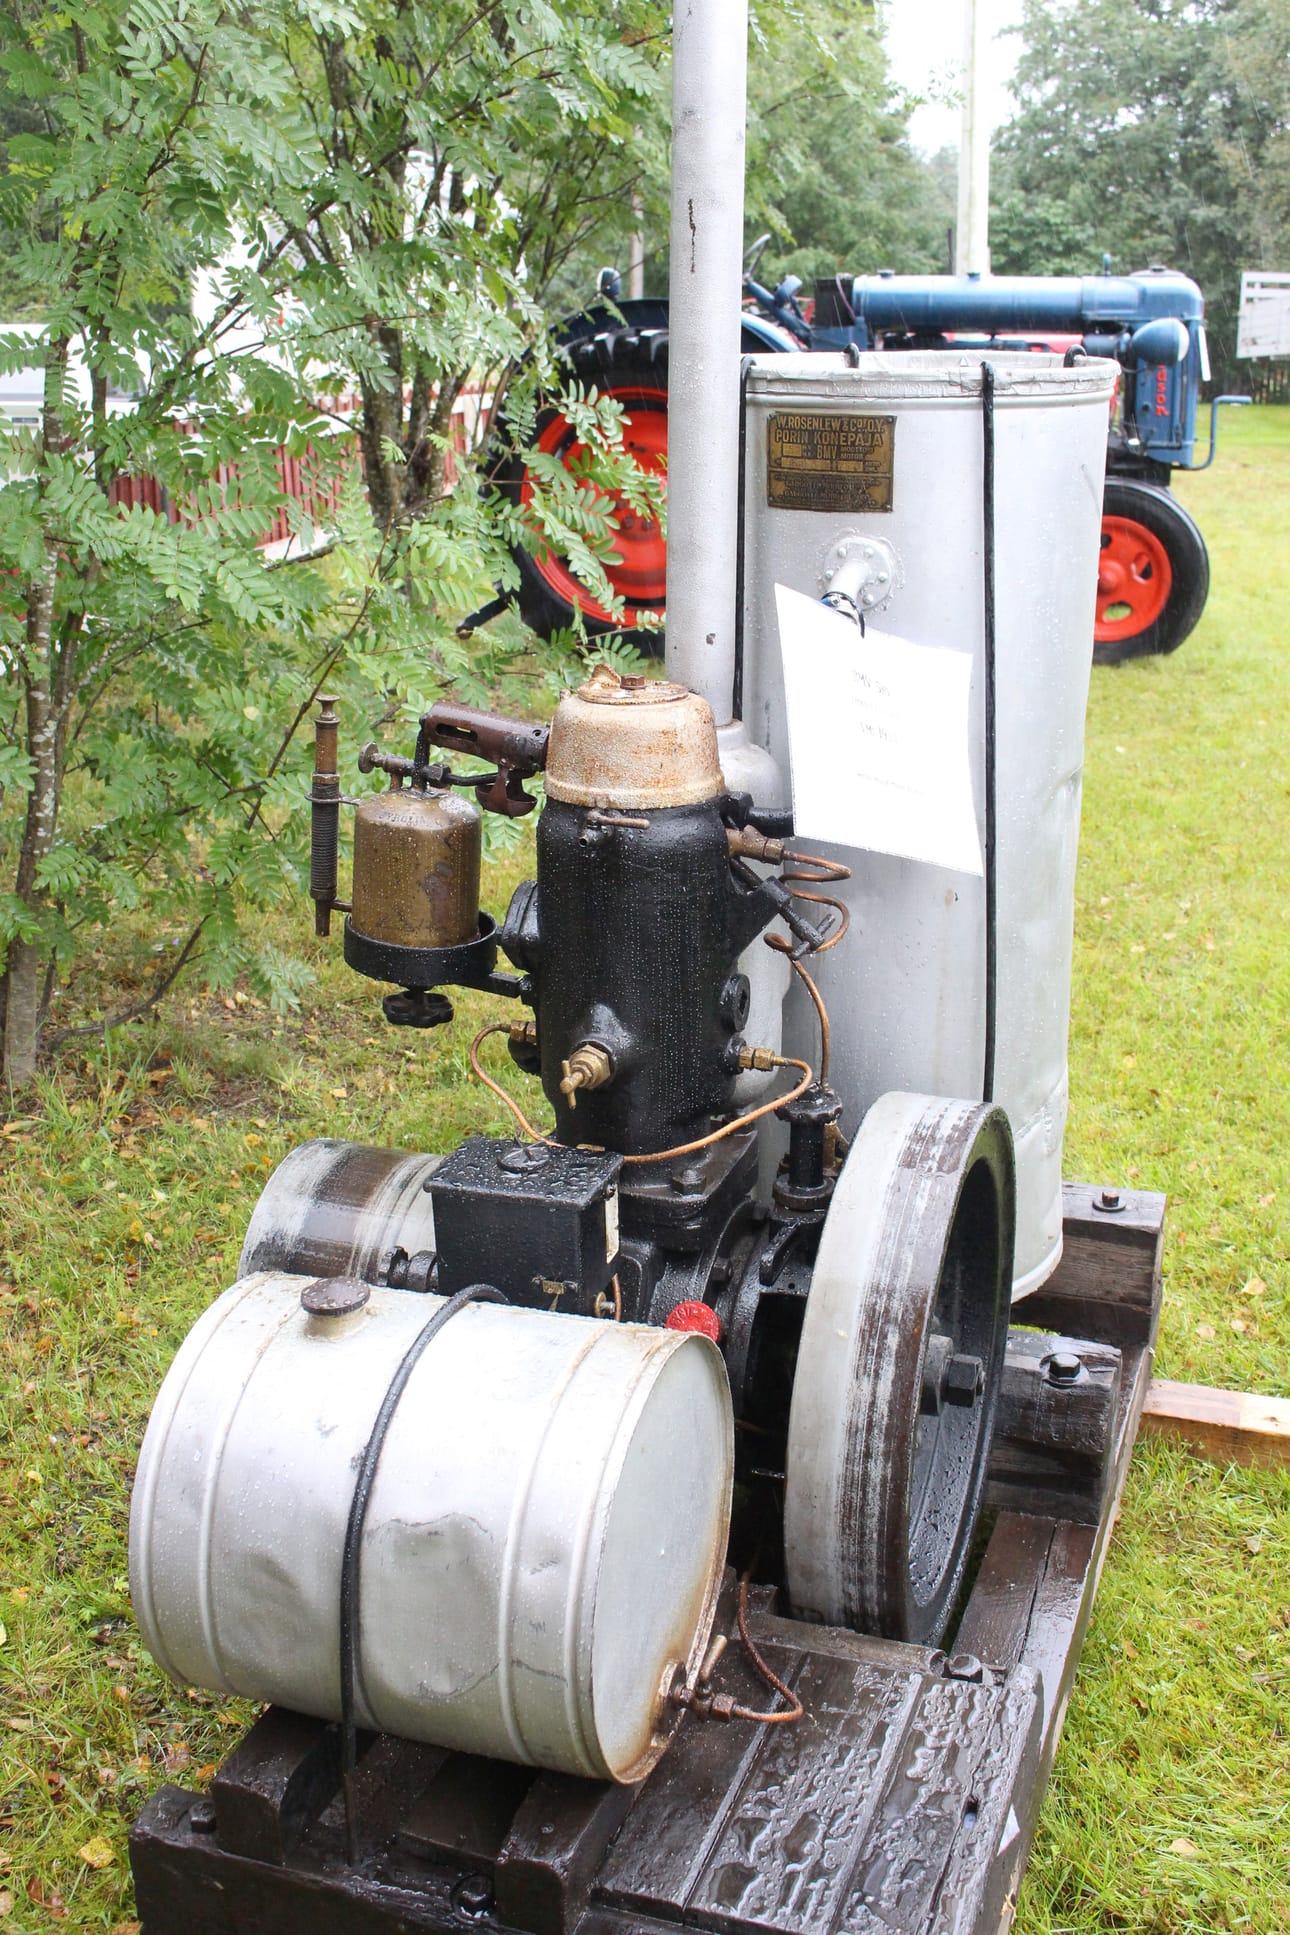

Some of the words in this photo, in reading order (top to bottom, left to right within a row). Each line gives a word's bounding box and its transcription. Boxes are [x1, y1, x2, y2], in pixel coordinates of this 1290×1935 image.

[776, 429, 809, 444] PORIN
[813, 432, 882, 446] KONEPAJA
[816, 445, 838, 459] BMV
